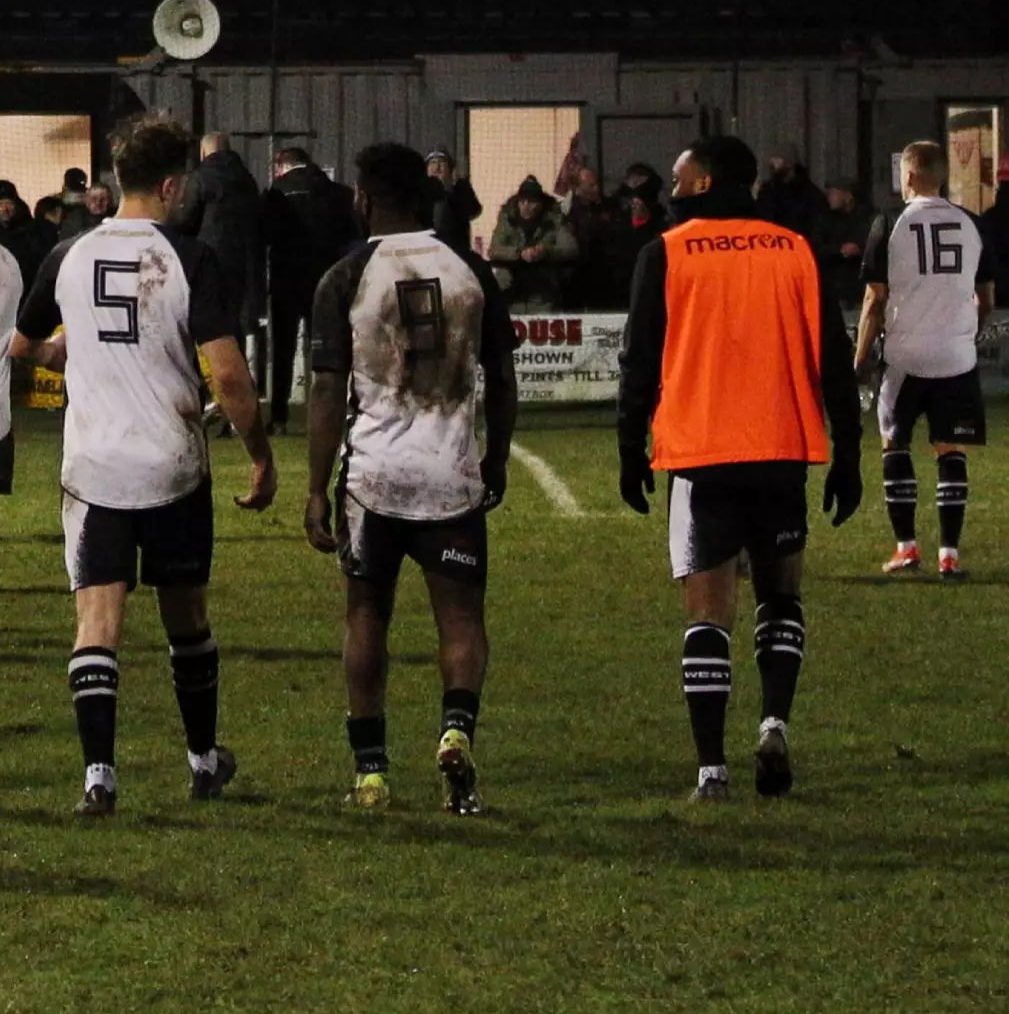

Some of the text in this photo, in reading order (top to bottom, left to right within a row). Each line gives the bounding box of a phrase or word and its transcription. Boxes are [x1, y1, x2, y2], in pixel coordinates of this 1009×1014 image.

[685, 234, 795, 255] macron
[909, 223, 963, 276] 16
[93, 259, 139, 344] 5
[512, 320, 582, 345] OUSE
